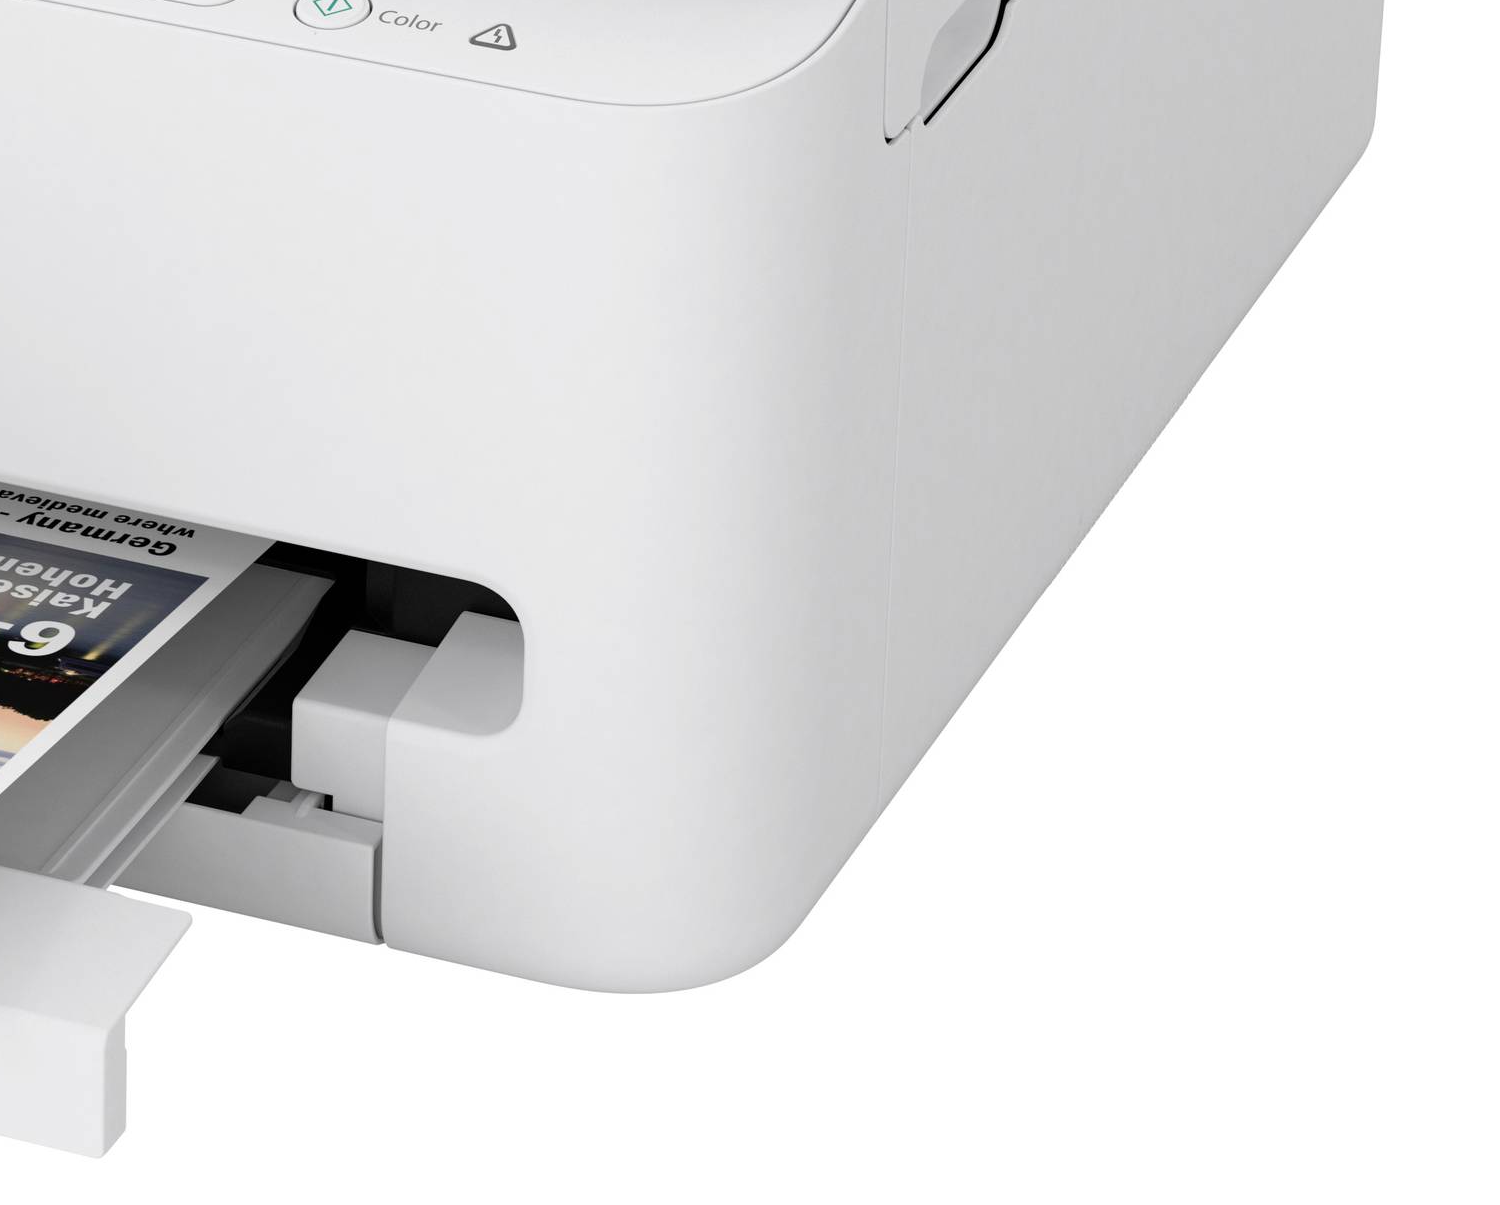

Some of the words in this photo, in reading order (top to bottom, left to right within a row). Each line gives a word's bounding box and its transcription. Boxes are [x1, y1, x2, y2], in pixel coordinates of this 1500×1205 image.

[378, 10, 444, 33] Color
[16, 511, 177, 556] Germany
[114, 514, 195, 540] where
